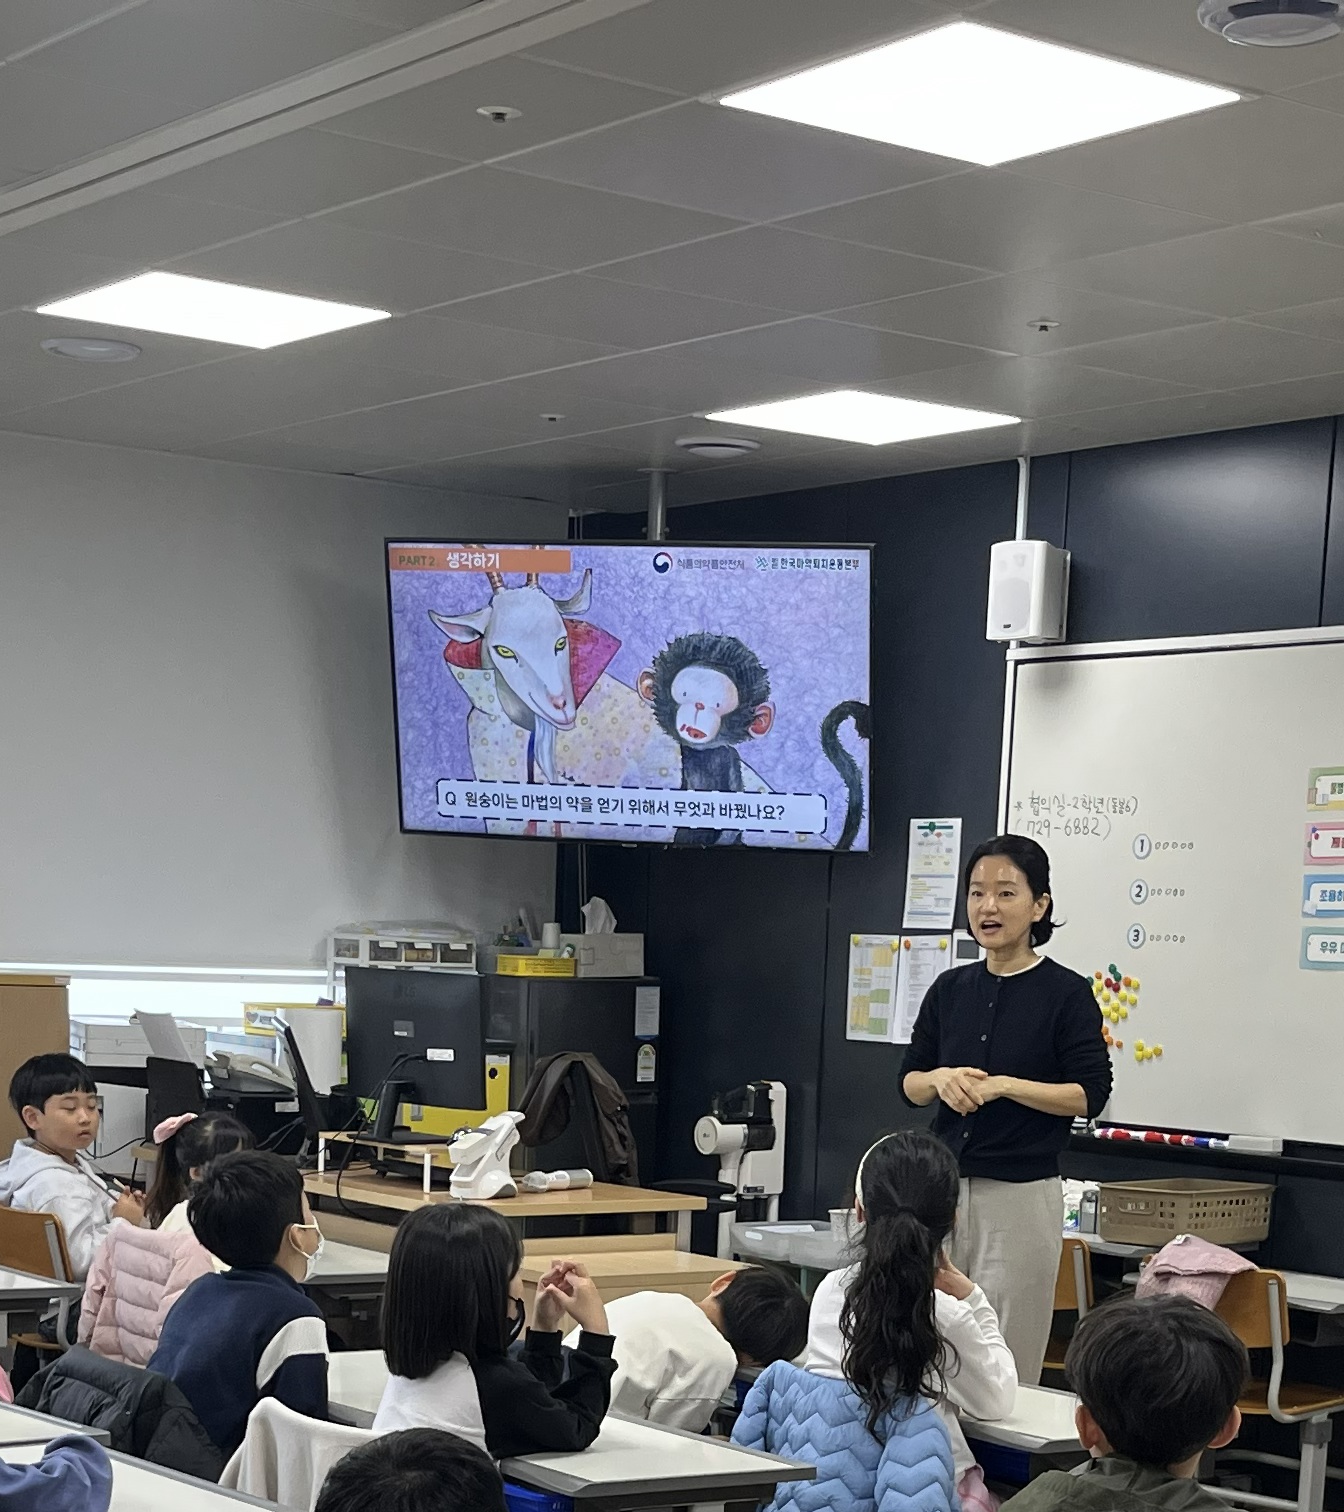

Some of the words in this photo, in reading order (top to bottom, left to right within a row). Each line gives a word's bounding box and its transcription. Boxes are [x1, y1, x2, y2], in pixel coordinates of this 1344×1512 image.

[446, 551, 501, 569] 생각하기
[677, 558, 745, 570] 식품의약품안전처
[445, 791, 456, 805] Q
[465, 791, 518, 810] 원숭이는
[521, 793, 563, 812] 마법의
[566, 795, 594, 813] 약을
[597, 797, 624, 815] 얻기
[628, 799, 669, 817] 위해서
[673, 801, 716, 819] 무엇과
[719, 803, 785, 821] 바꿨나요?
[1319, 941, 1339, 954] 우유
